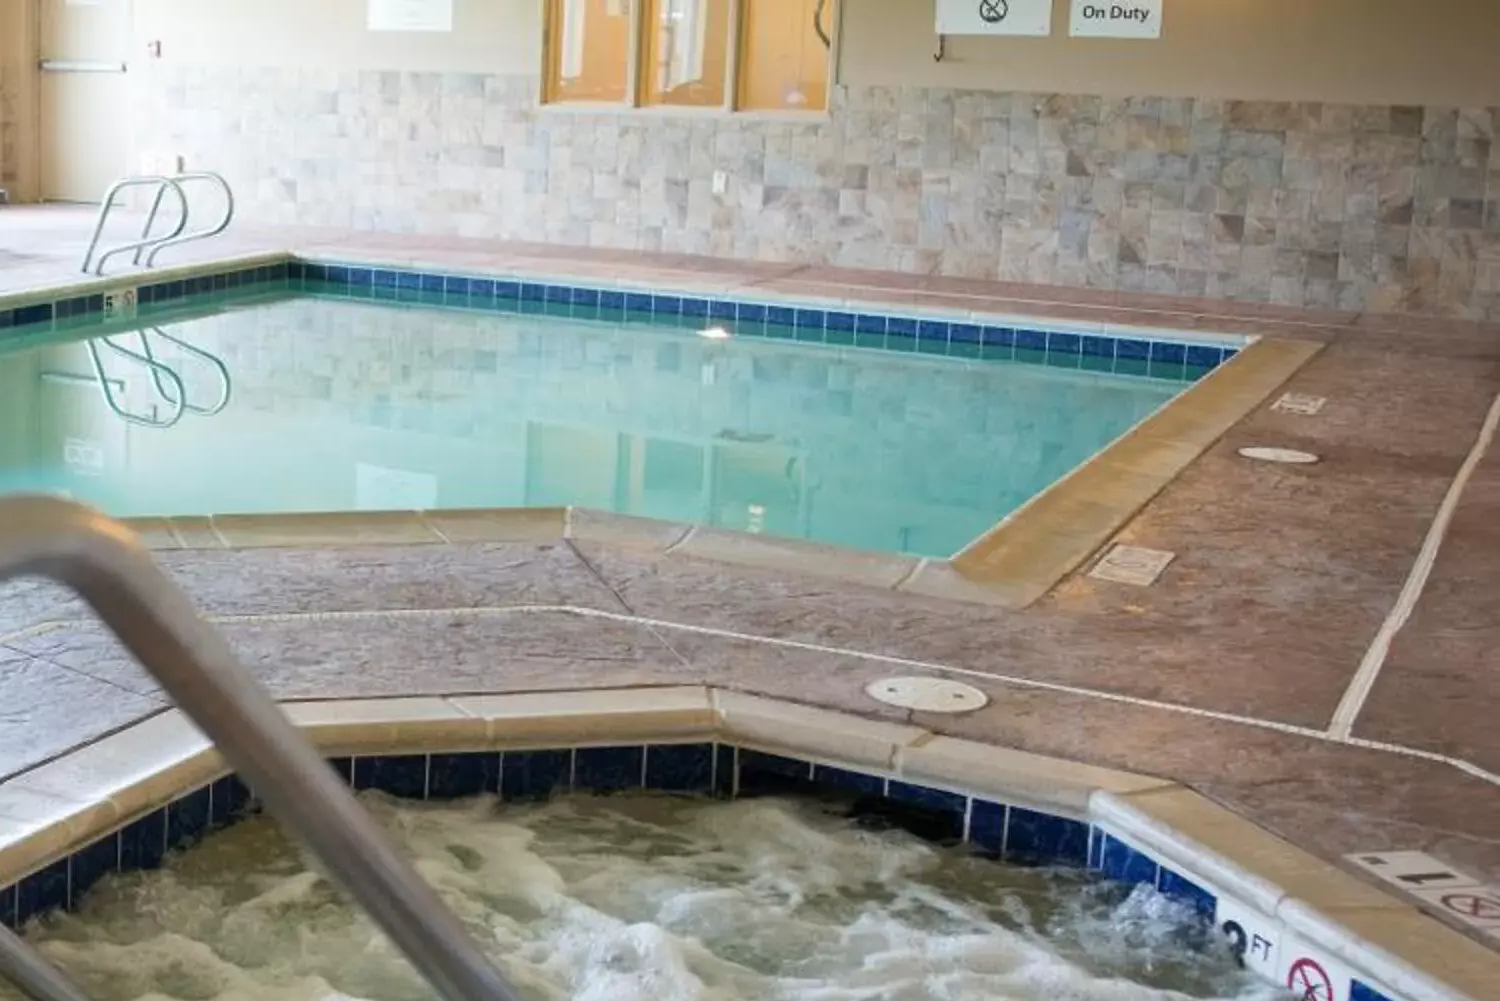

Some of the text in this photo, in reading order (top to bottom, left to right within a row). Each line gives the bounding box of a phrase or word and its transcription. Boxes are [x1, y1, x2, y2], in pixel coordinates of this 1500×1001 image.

[1083, 5, 1150, 24] On Duty
[1251, 932, 1274, 961] FT
